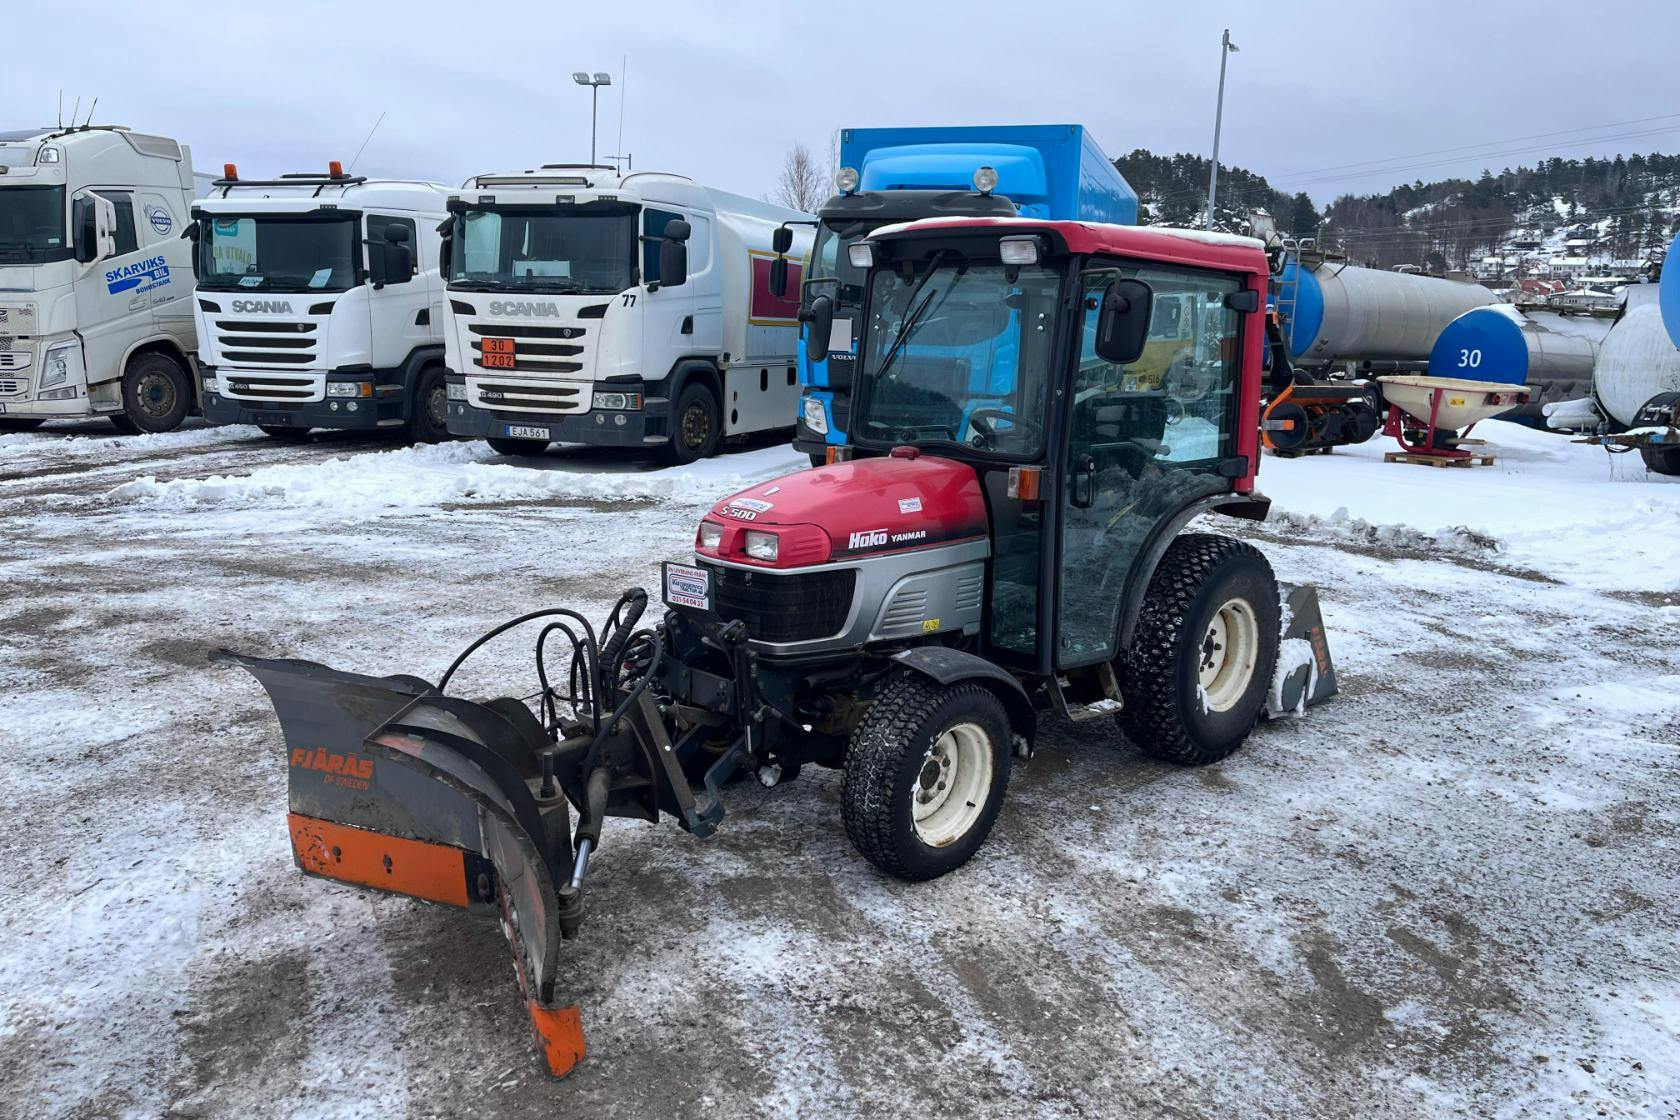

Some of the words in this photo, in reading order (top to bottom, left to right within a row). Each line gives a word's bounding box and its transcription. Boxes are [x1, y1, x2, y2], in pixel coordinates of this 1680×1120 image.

[105, 256, 166, 281] SKARVIKS
[154, 268, 168, 279] BIL
[231, 300, 293, 314] SCANIA
[622, 294, 636, 307] 77
[489, 301, 560, 317] SCANIA
[491, 340, 505, 351] 30
[484, 355, 512, 367] 1202
[1457, 349, 1482, 368] 30
[512, 427, 529, 437] EJA
[530, 428, 546, 438] 561
[721, 507, 730, 515] S
[729, 509, 757, 521] 500
[848, 528, 888, 549] Hako
[891, 530, 926, 543] YANMAR
[290, 746, 374, 779] FJÄRÅS
[335, 777, 369, 791] SWEDEN
